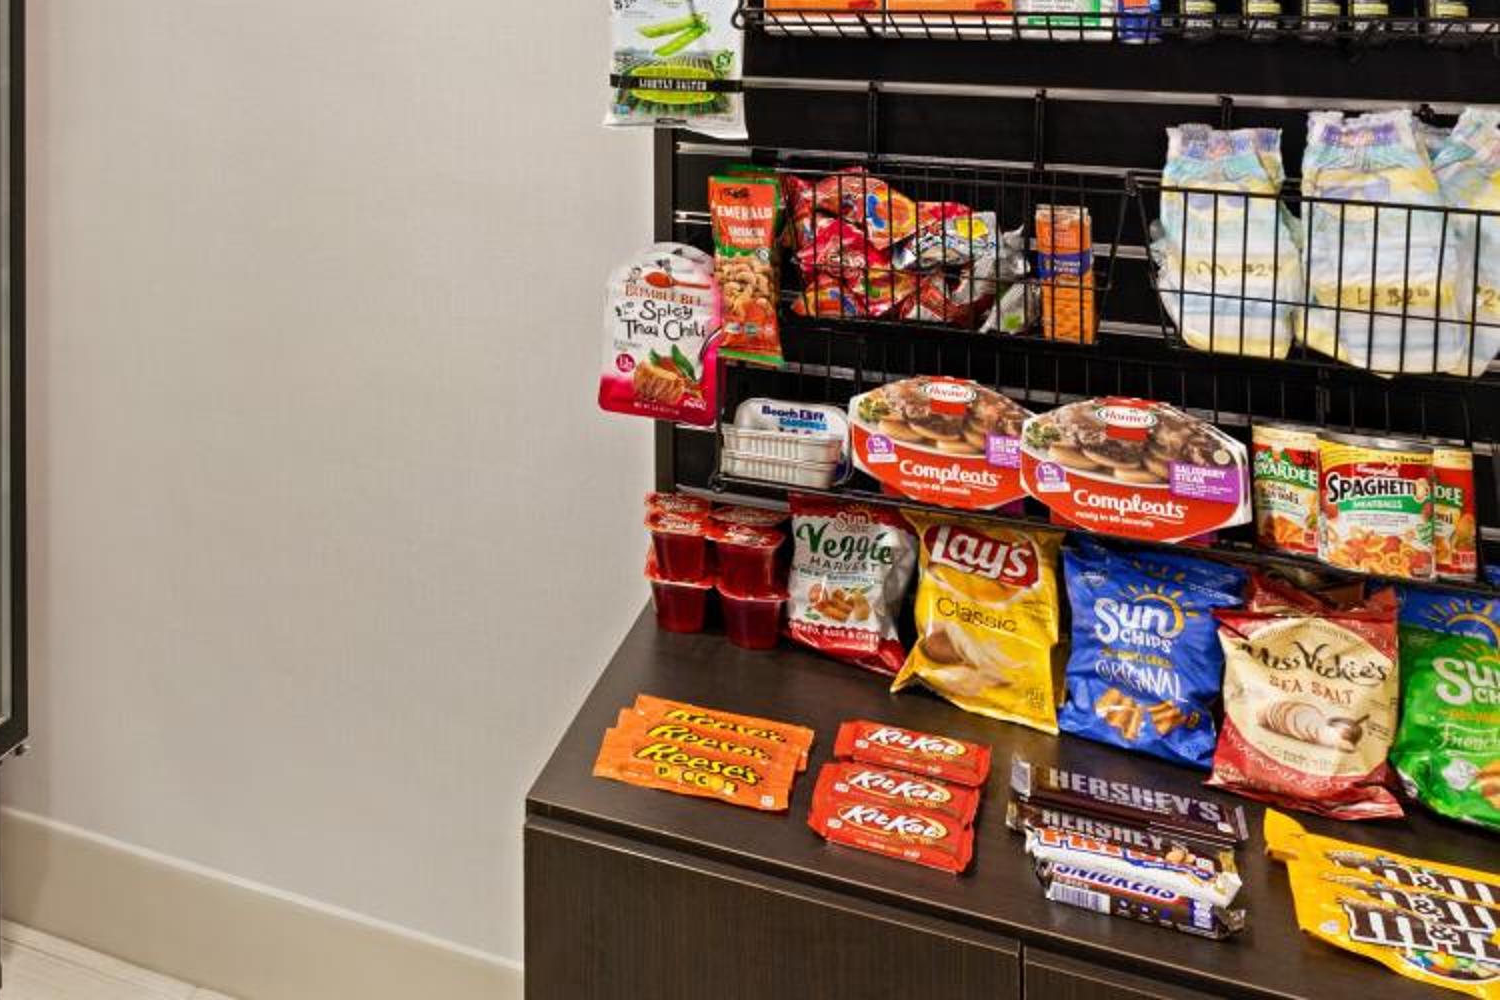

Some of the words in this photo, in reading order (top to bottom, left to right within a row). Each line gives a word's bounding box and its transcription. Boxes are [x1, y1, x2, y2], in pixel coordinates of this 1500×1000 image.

[717, 205, 772, 220] EMERALD
[640, 300, 693, 324] Spicy
[621, 319, 659, 339] Thai
[664, 320, 706, 341] Chili
[762, 405, 798, 419] Beach
[1106, 411, 1150, 424] Hormel
[900, 459, 998, 487] Compleats
[1073, 489, 1185, 519] Compleats
[796, 522, 893, 565] Veggie
[931, 526, 1031, 579] Lay's
[810, 555, 881, 572] HARVEST
[936, 597, 1018, 633] Classic
[1094, 597, 1168, 644] Sun
[1119, 628, 1173, 653] CHIPS
[1294, 640, 1388, 682] Vickie's
[1269, 674, 1303, 694] SEA
[1310, 681, 1354, 705] SALT
[634, 743, 758, 786] Reese's
[1051, 767, 1222, 823] HERSHEY'S
